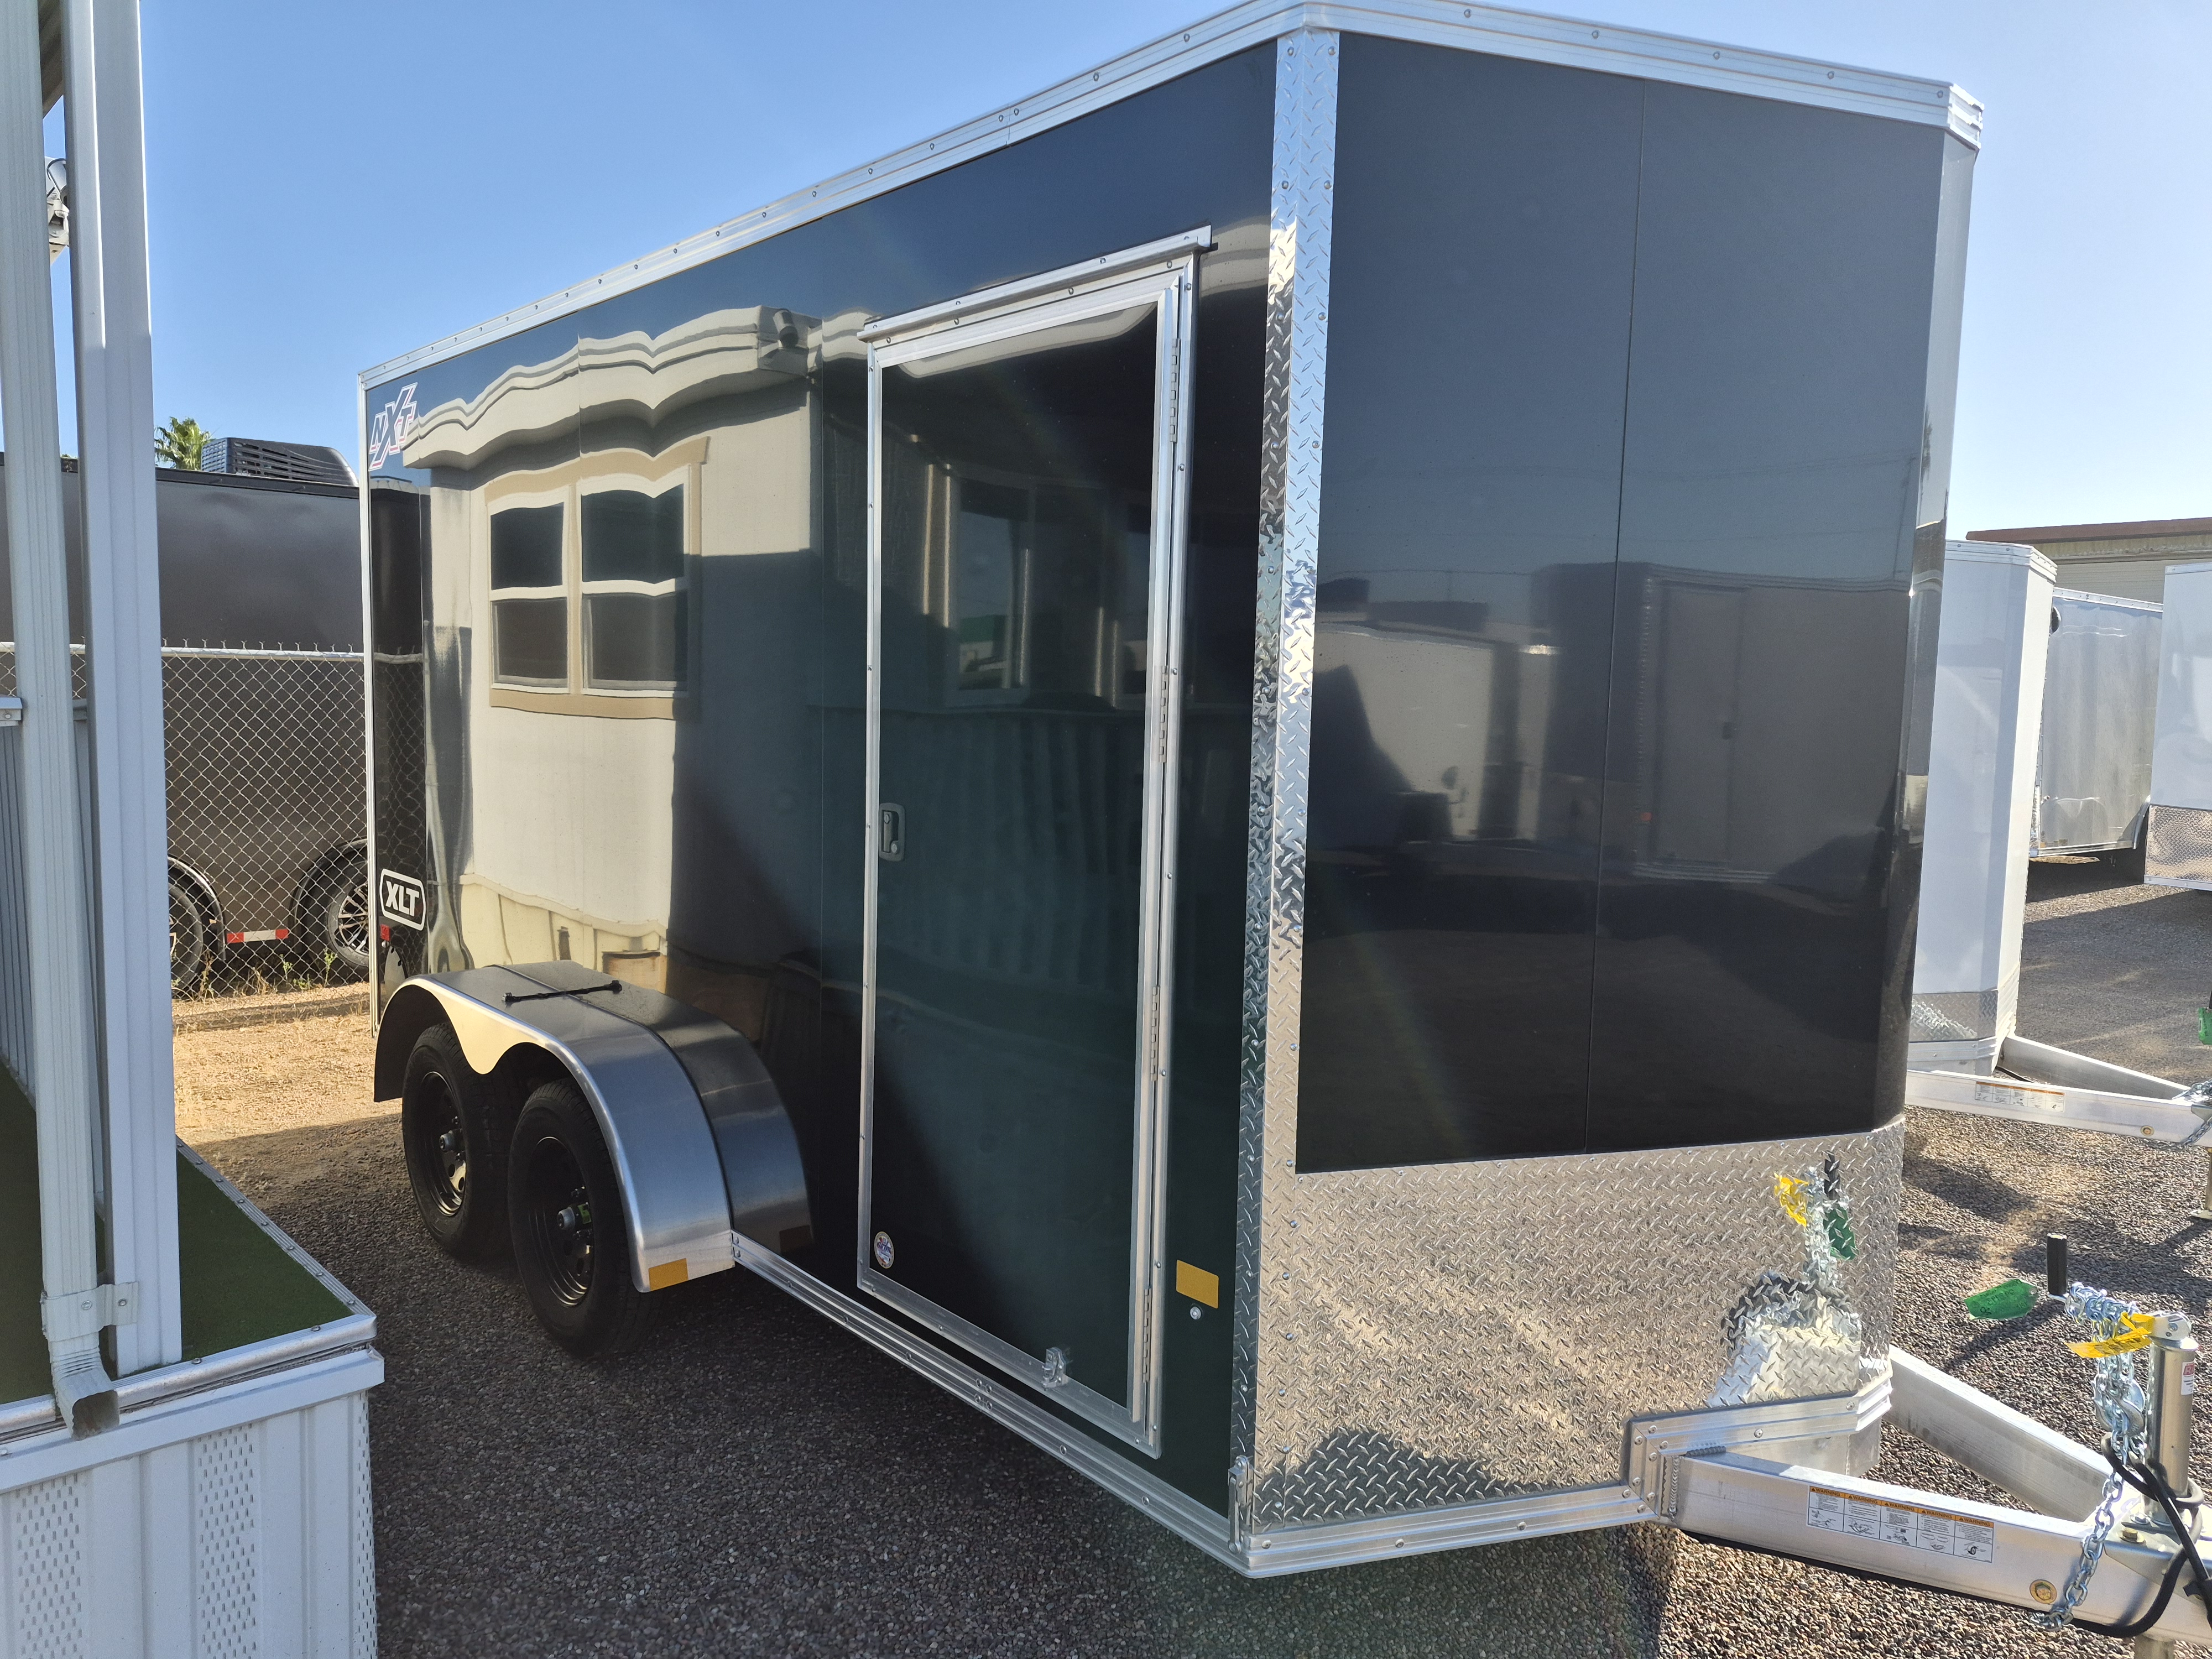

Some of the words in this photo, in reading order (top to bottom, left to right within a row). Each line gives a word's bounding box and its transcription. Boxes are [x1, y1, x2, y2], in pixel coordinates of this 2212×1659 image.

[368, 382, 418, 471] NXT
[385, 880, 419, 917] XLT
[1816, 1488, 1840, 1496] WARNING
[1853, 1495, 1878, 1504] WARNING
[1889, 1503, 1914, 1511] WARNING
[1927, 1510, 1952, 1519] WARNING
[1964, 1517, 1990, 1526] WARNING
